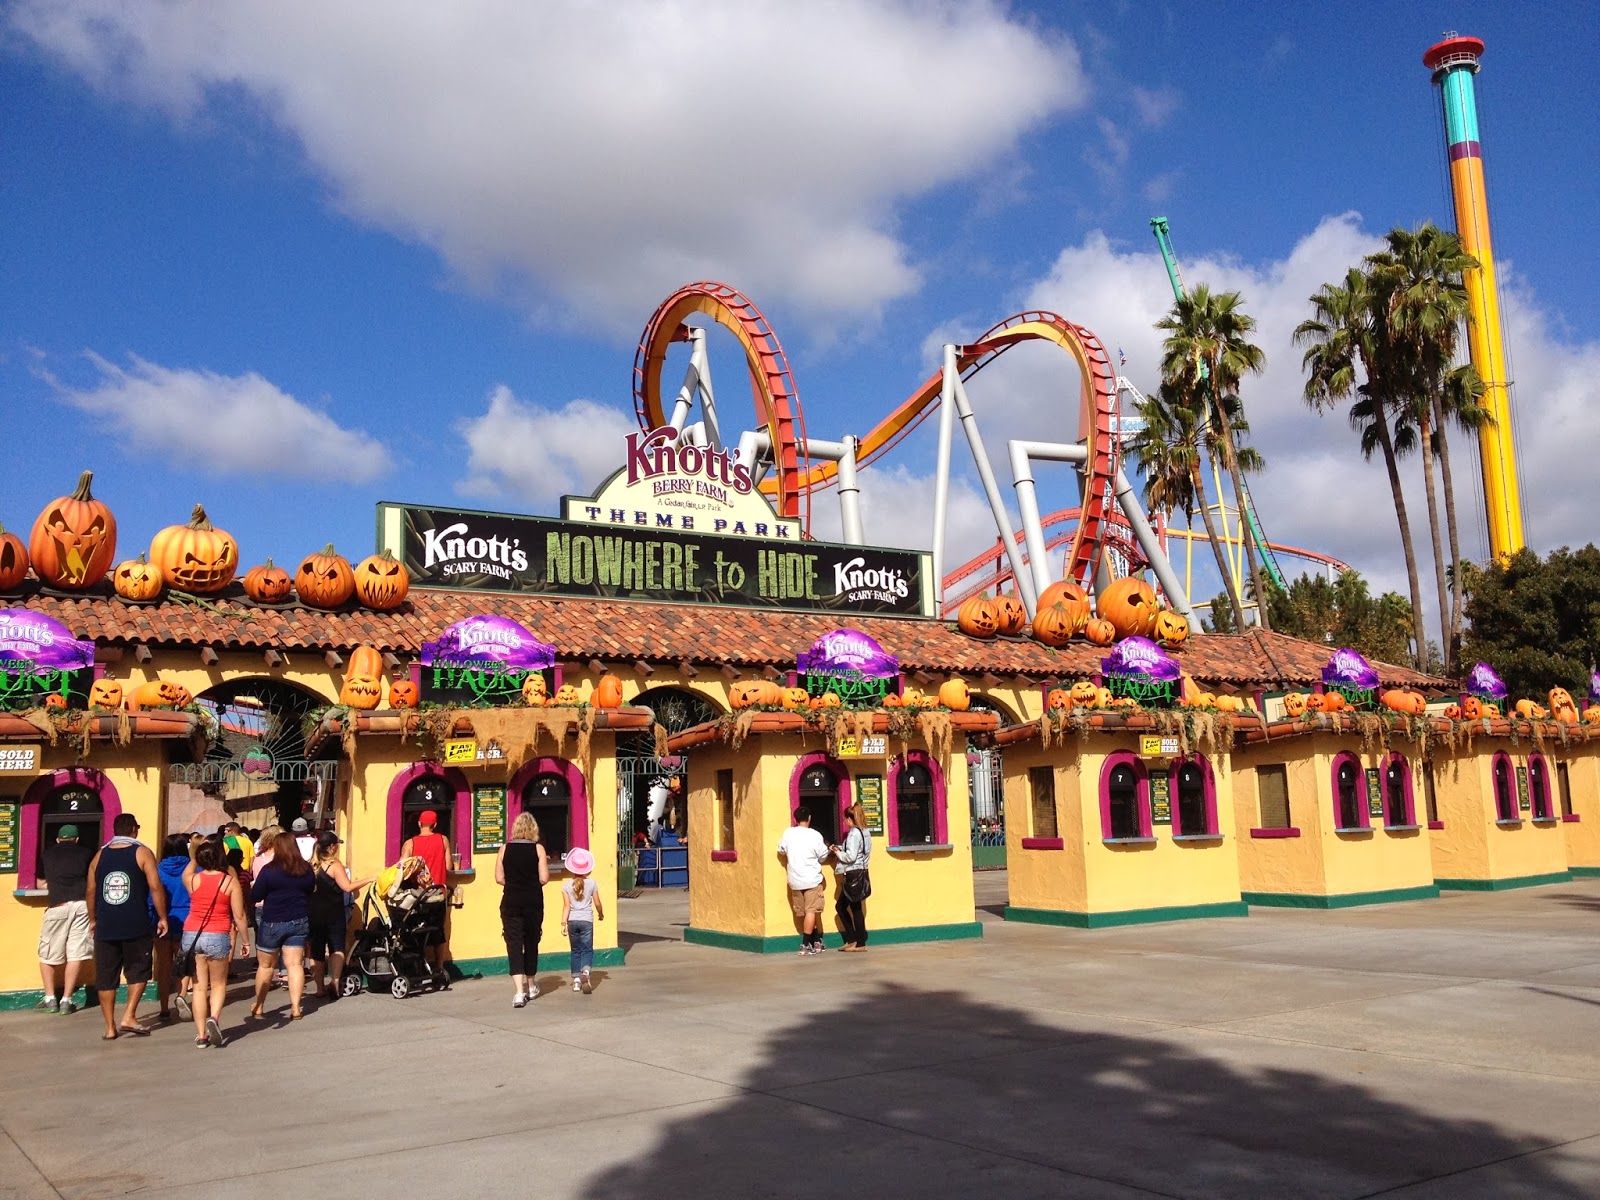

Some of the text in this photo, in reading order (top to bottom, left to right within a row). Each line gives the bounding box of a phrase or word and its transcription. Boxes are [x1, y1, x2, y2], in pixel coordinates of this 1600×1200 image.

[625, 426, 752, 494] Knott's
[653, 478, 728, 504] BERRY FARM
[707, 503, 721, 512] Park
[585, 506, 789, 538] THEME PARK
[423, 522, 528, 572] Knott's
[443, 561, 510, 581] SCARY FARM
[546, 531, 820, 600] NOWHERE to HIDE
[833, 557, 909, 598] Knott's
[848, 590, 896, 605] SCARY FARM
[459, 621, 521, 651] Knott's
[825, 634, 874, 661] Knott's
[433, 659, 506, 670] HALLOWEEN
[807, 676, 890, 697] HAUNT
[1109, 679, 1174, 701] HAUNT
[0, 750, 34, 760] SOLD
[862, 746, 885, 754] HERE
[814, 778, 820, 787] 5
[909, 776, 915, 785] 6
[425, 790, 433, 800] 3
[541, 787, 549, 796] 4
[70, 800, 78, 810] 2
